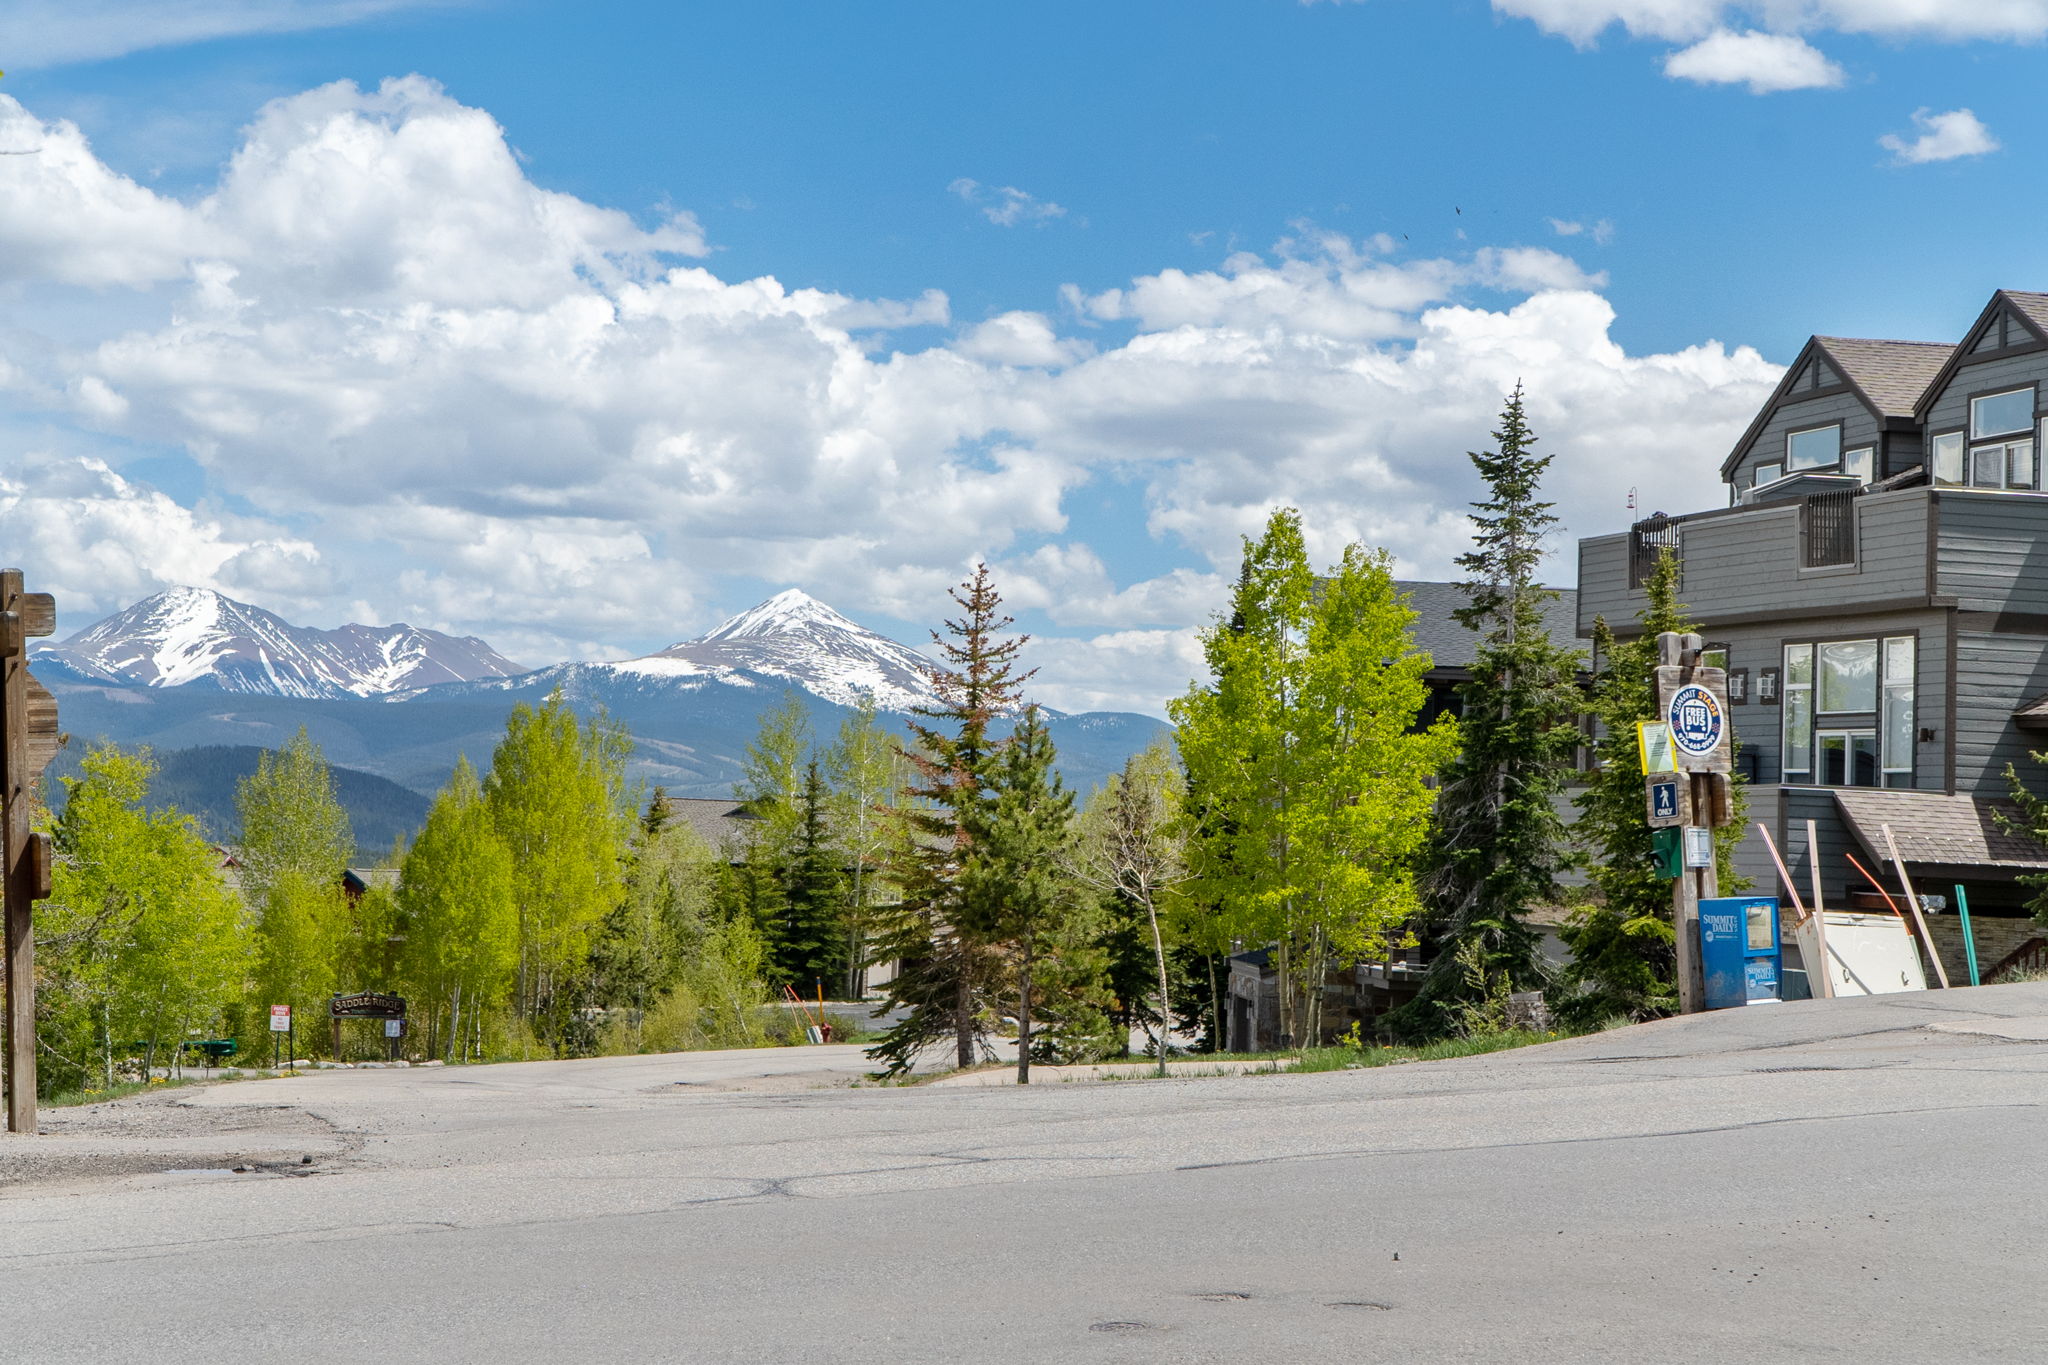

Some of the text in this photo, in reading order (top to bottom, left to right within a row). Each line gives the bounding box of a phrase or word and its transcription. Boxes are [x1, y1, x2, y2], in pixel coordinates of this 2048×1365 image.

[1673, 689, 1719, 717] SUMMIT STAGE
[1685, 707, 1706, 718] FREE
[1686, 716, 1706, 726] BUS
[1657, 808, 1673, 817] ONLY
[1703, 914, 1735, 925] SUMMIT
[1712, 923, 1734, 932] DAILY
[335, 997, 401, 1011] SADDLE RIDGE
